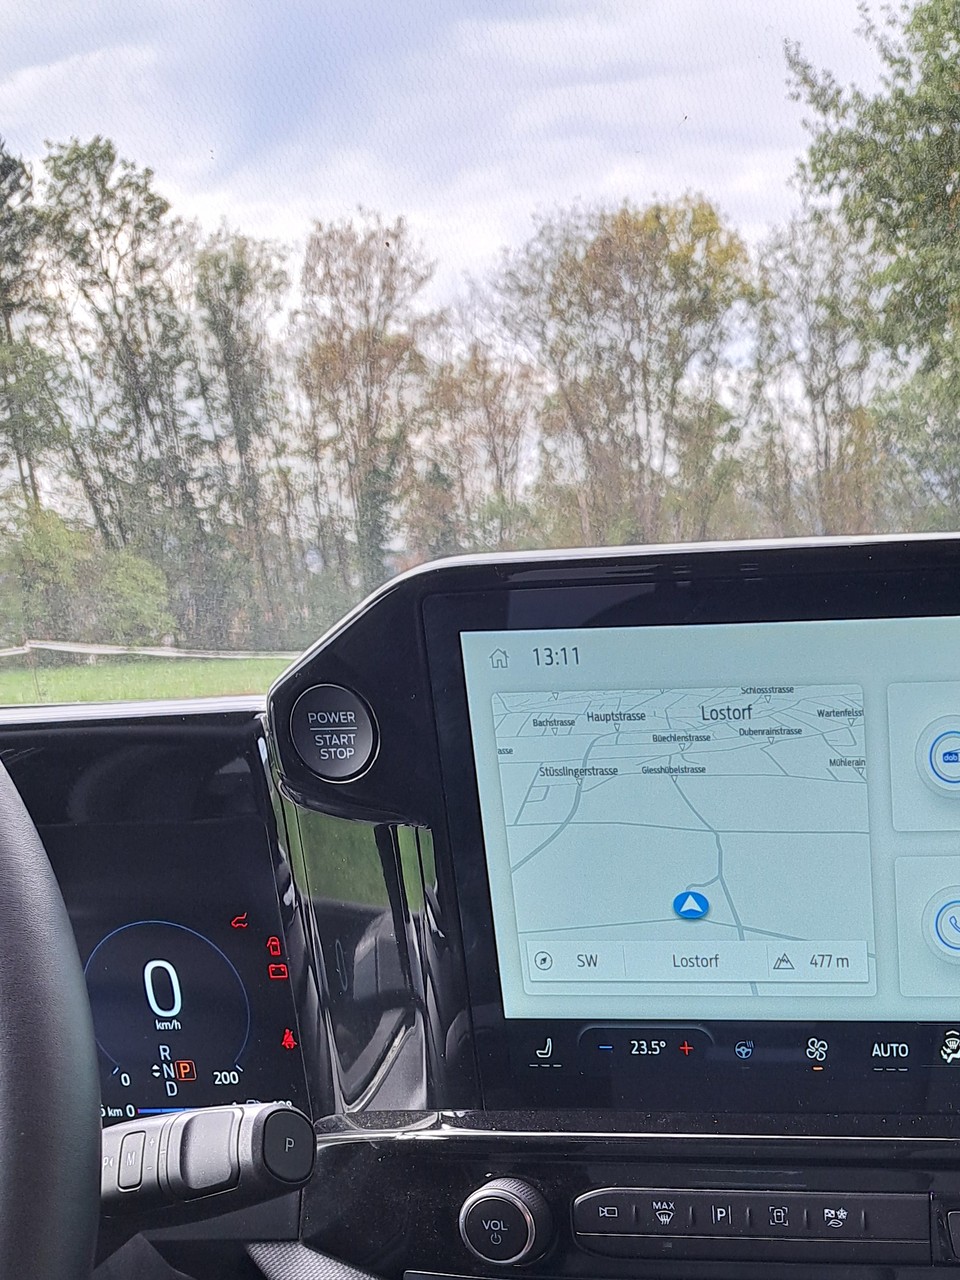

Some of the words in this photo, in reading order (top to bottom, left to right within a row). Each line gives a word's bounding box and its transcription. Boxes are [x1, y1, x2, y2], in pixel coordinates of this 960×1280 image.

[532, 647, 580, 666] 13:11
[741, 686, 795, 695] Schlossstrasse
[308, 711, 356, 723] POWER
[587, 711, 646, 723] Hauptstrasse
[701, 704, 753, 721] Lostorf
[532, 718, 576, 728] Bachstrasse
[315, 734, 356, 746] START
[320, 747, 355, 760] STOP
[539, 767, 619, 779] Stüsslingerstrasse
[577, 953, 598, 967] SW
[672, 953, 720, 969] Lostorf
[809, 953, 832, 969] 477
[836, 957, 850, 968] m
[144, 959, 182, 1018] 0
[155, 1019, 182, 1031] km/h
[159, 1045, 172, 1061] R
[630, 1040, 667, 1056] 23.5°
[872, 1043, 910, 1058] AUTO
[162, 1063, 176, 1079] N
[179, 1063, 191, 1079] P
[213, 1071, 240, 1085] 200
[120, 1073, 131, 1087] 0
[165, 1081, 179, 1097] D
[107, 1105, 124, 1117] km
[285, 1138, 296, 1152] P
[652, 1201, 676, 1211] MAX
[482, 1219, 508, 1232] VOL
